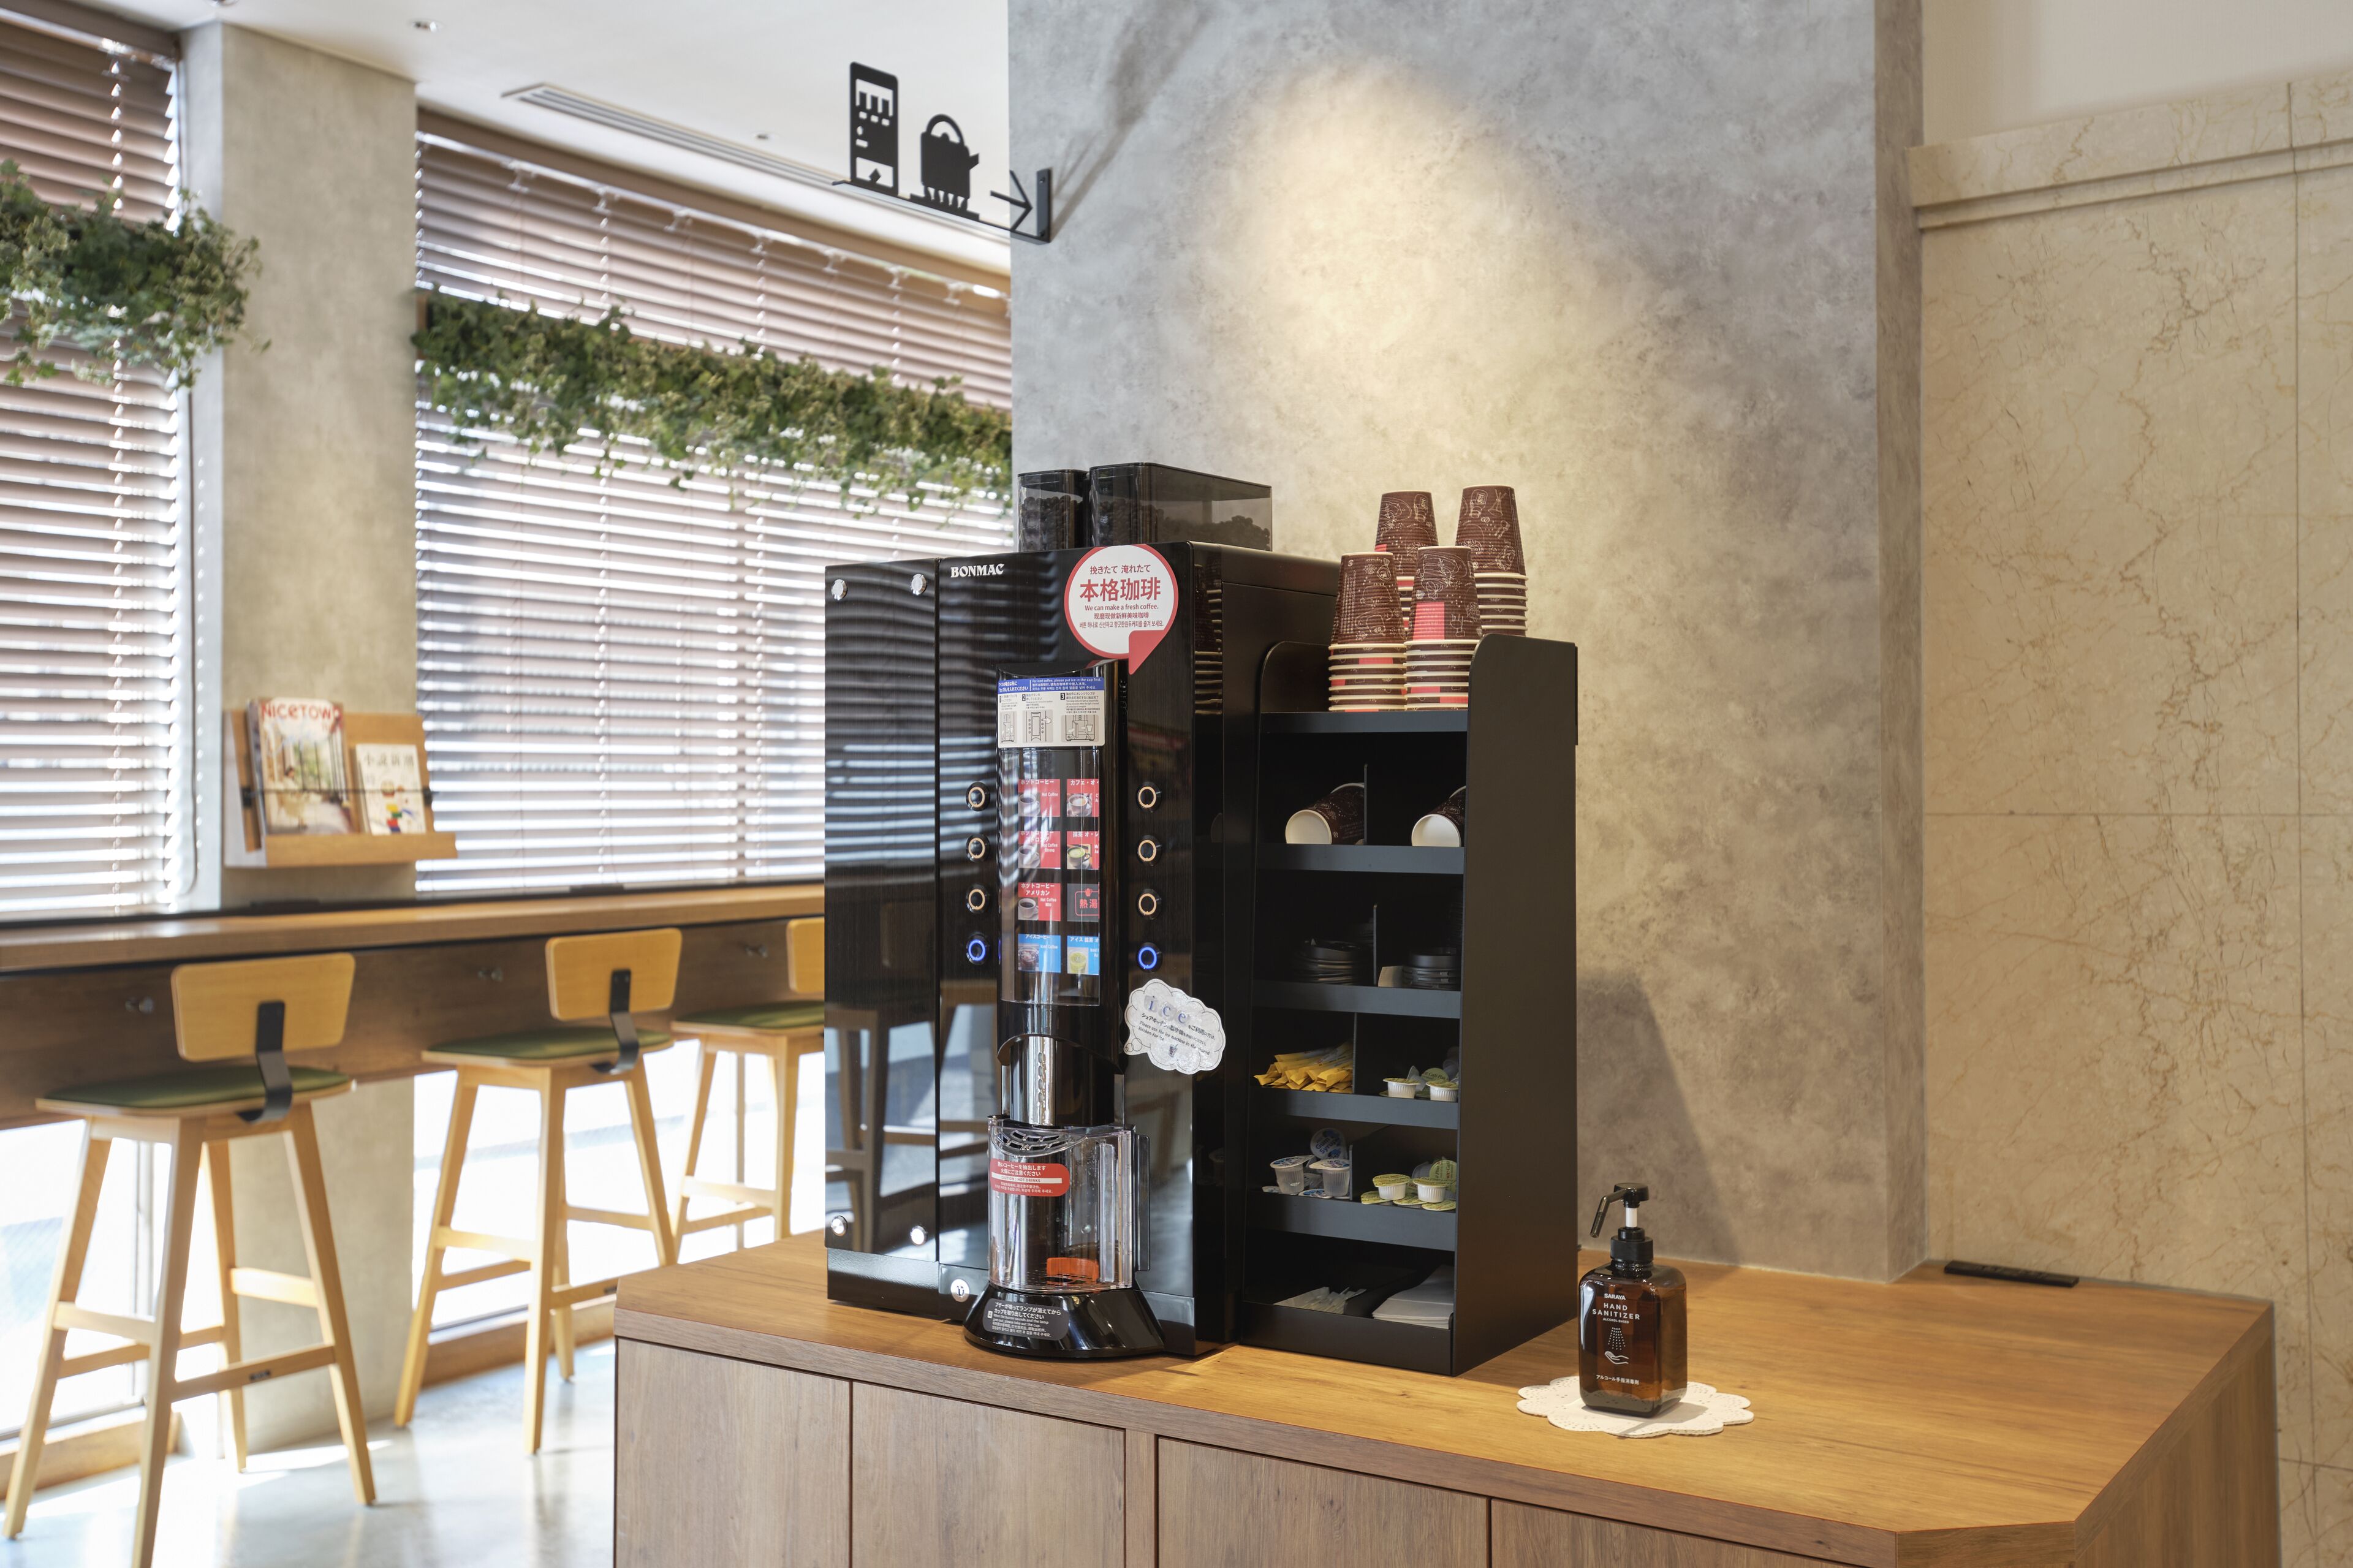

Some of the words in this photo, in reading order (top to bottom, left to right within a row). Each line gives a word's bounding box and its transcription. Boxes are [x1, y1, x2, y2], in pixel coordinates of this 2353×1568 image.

[950, 563, 1005, 578] BONMAC
[1090, 566, 1118, 575] 挽きたて
[1080, 577, 1161, 602] 本格珈琲
[1080, 899, 1097, 909] 熱湯
[1148, 995, 1187, 1024] ice
[1593, 1309, 1640, 1320] SANITIZER
